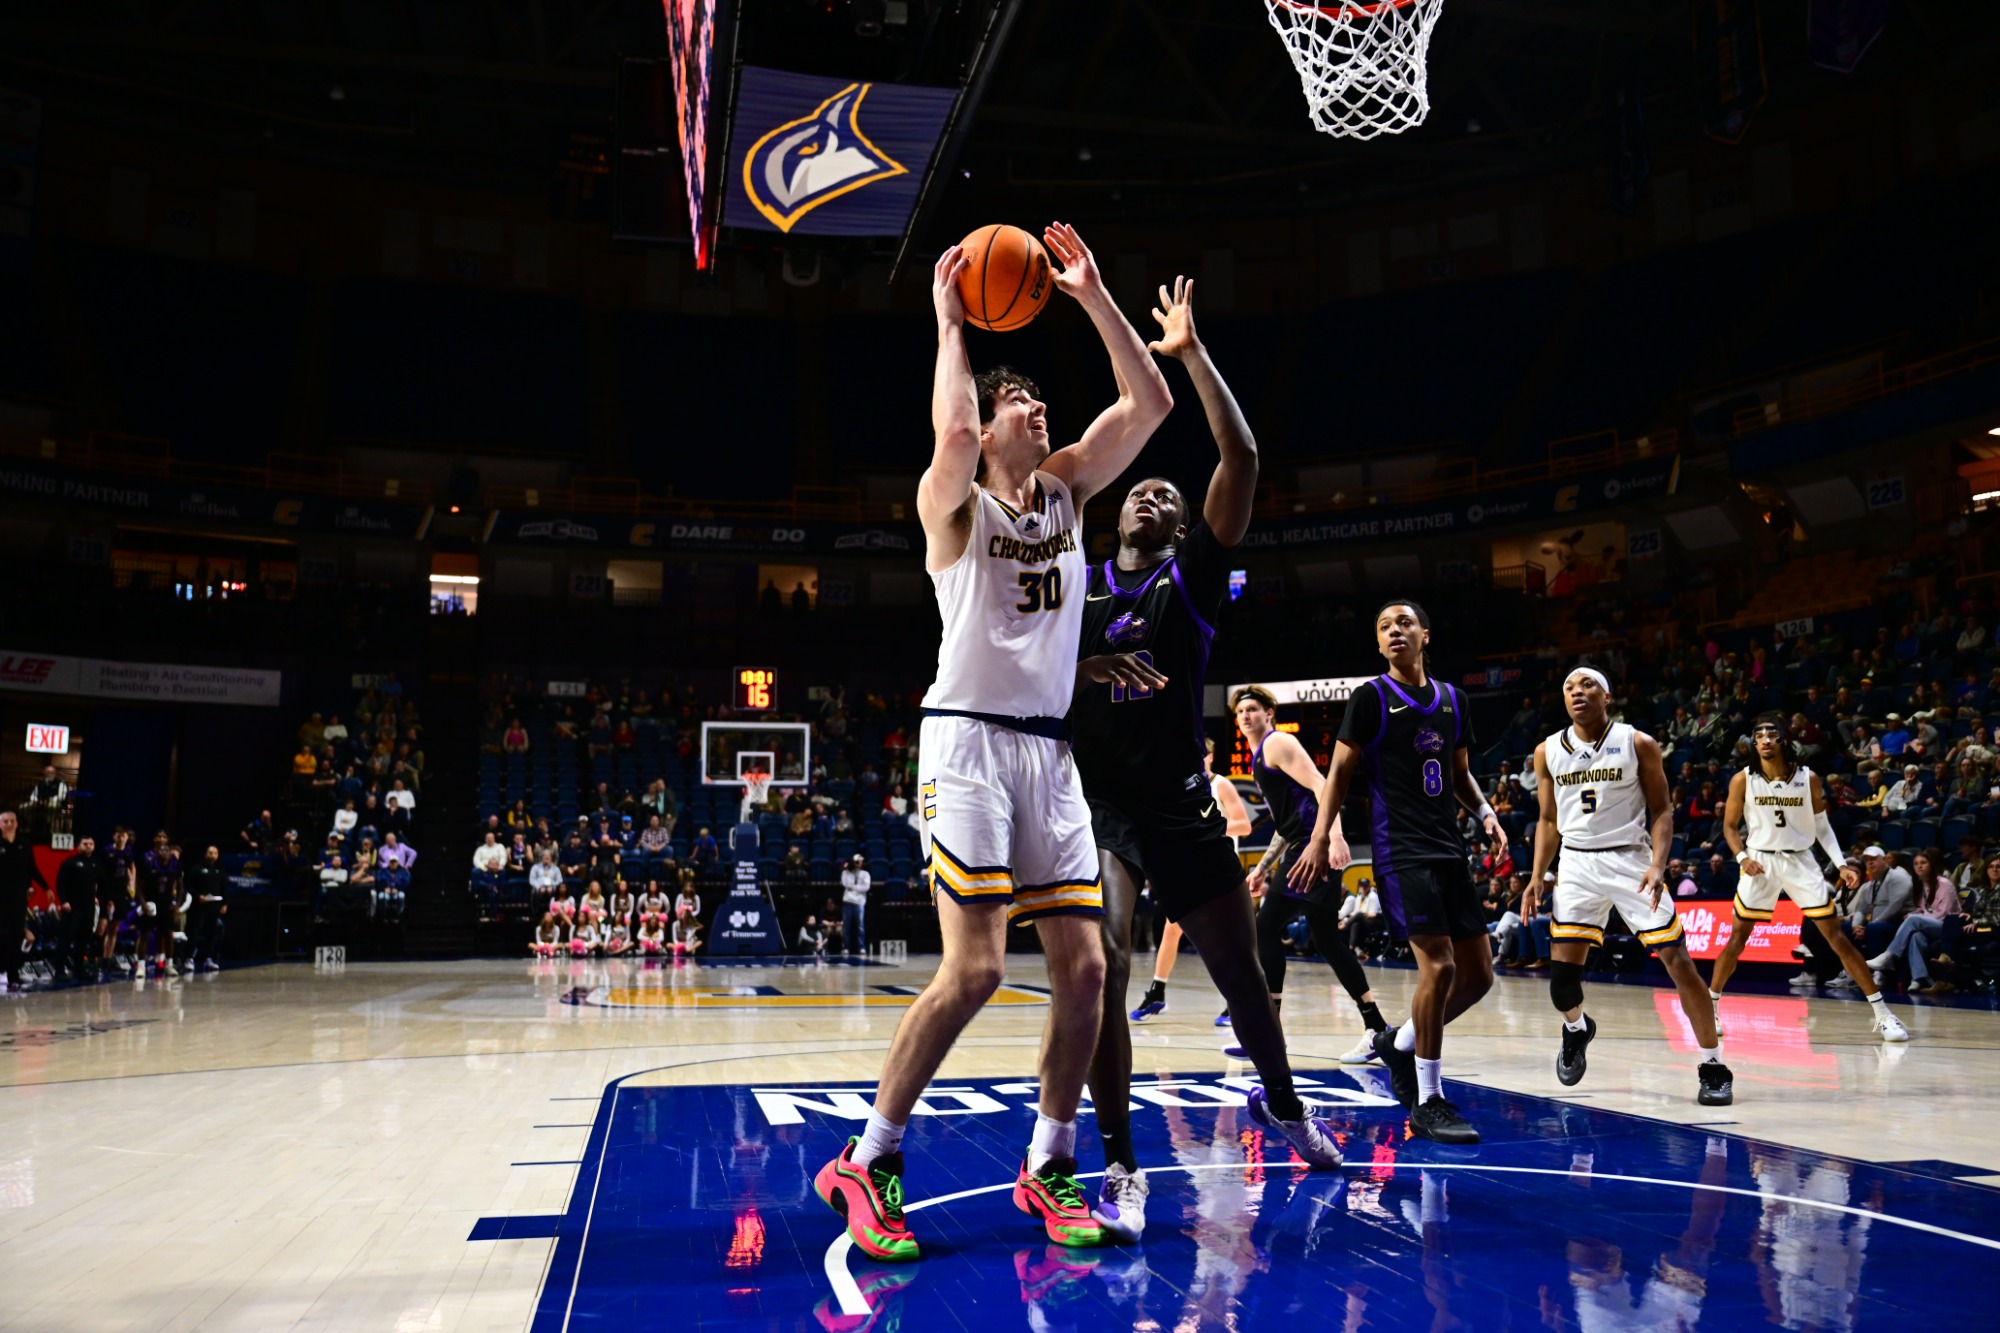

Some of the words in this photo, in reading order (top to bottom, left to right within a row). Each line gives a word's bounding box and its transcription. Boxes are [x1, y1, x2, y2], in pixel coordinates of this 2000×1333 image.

[0, 469, 59, 496] NKING
[64, 475, 150, 508] PARTNER
[1870, 480, 1903, 506] 226
[670, 524, 732, 541] DARE
[772, 529, 805, 543] DO
[1245, 531, 1278, 547] CIAL
[1283, 521, 1380, 544] HEALTHCARE
[1385, 512, 1454, 535] PARTNER
[989, 528, 1077, 565] CHATTANOOGA
[1629, 532, 1659, 554] 225
[574, 575, 600, 592] 221
[824, 582, 852, 598] 222
[1016, 566, 1063, 613] 30
[1781, 620, 1807, 636] 126
[2, 654, 55, 675] LEE
[101, 665, 150, 681] Heating
[161, 670, 180, 681] Air
[183, 671, 265, 687] Conditioning
[100, 680, 160, 695] Plumbing
[172, 684, 228, 697] Electrical
[747, 685, 769, 708] 16
[1297, 681, 1352, 701] unum
[29, 726, 66, 751] EXIT
[1422, 758, 1444, 797] 8
[1556, 767, 1623, 787] CHATTANOOGA
[1581, 789, 1597, 814] 5
[1754, 796, 1804, 807] CHATTANOOGA
[1774, 810, 1787, 828] 3
[55, 834, 73, 848] 117
[1680, 908, 1713, 933] PAPA
[1754, 922, 1802, 938] ngredients
[722, 930, 731, 939] of
[732, 931, 768, 941] Tennessee
[1686, 934, 1711, 952] HNS
[1746, 934, 1771, 947] Pizza.
[317, 947, 344, 963] 120
[883, 941, 903, 955] 121
